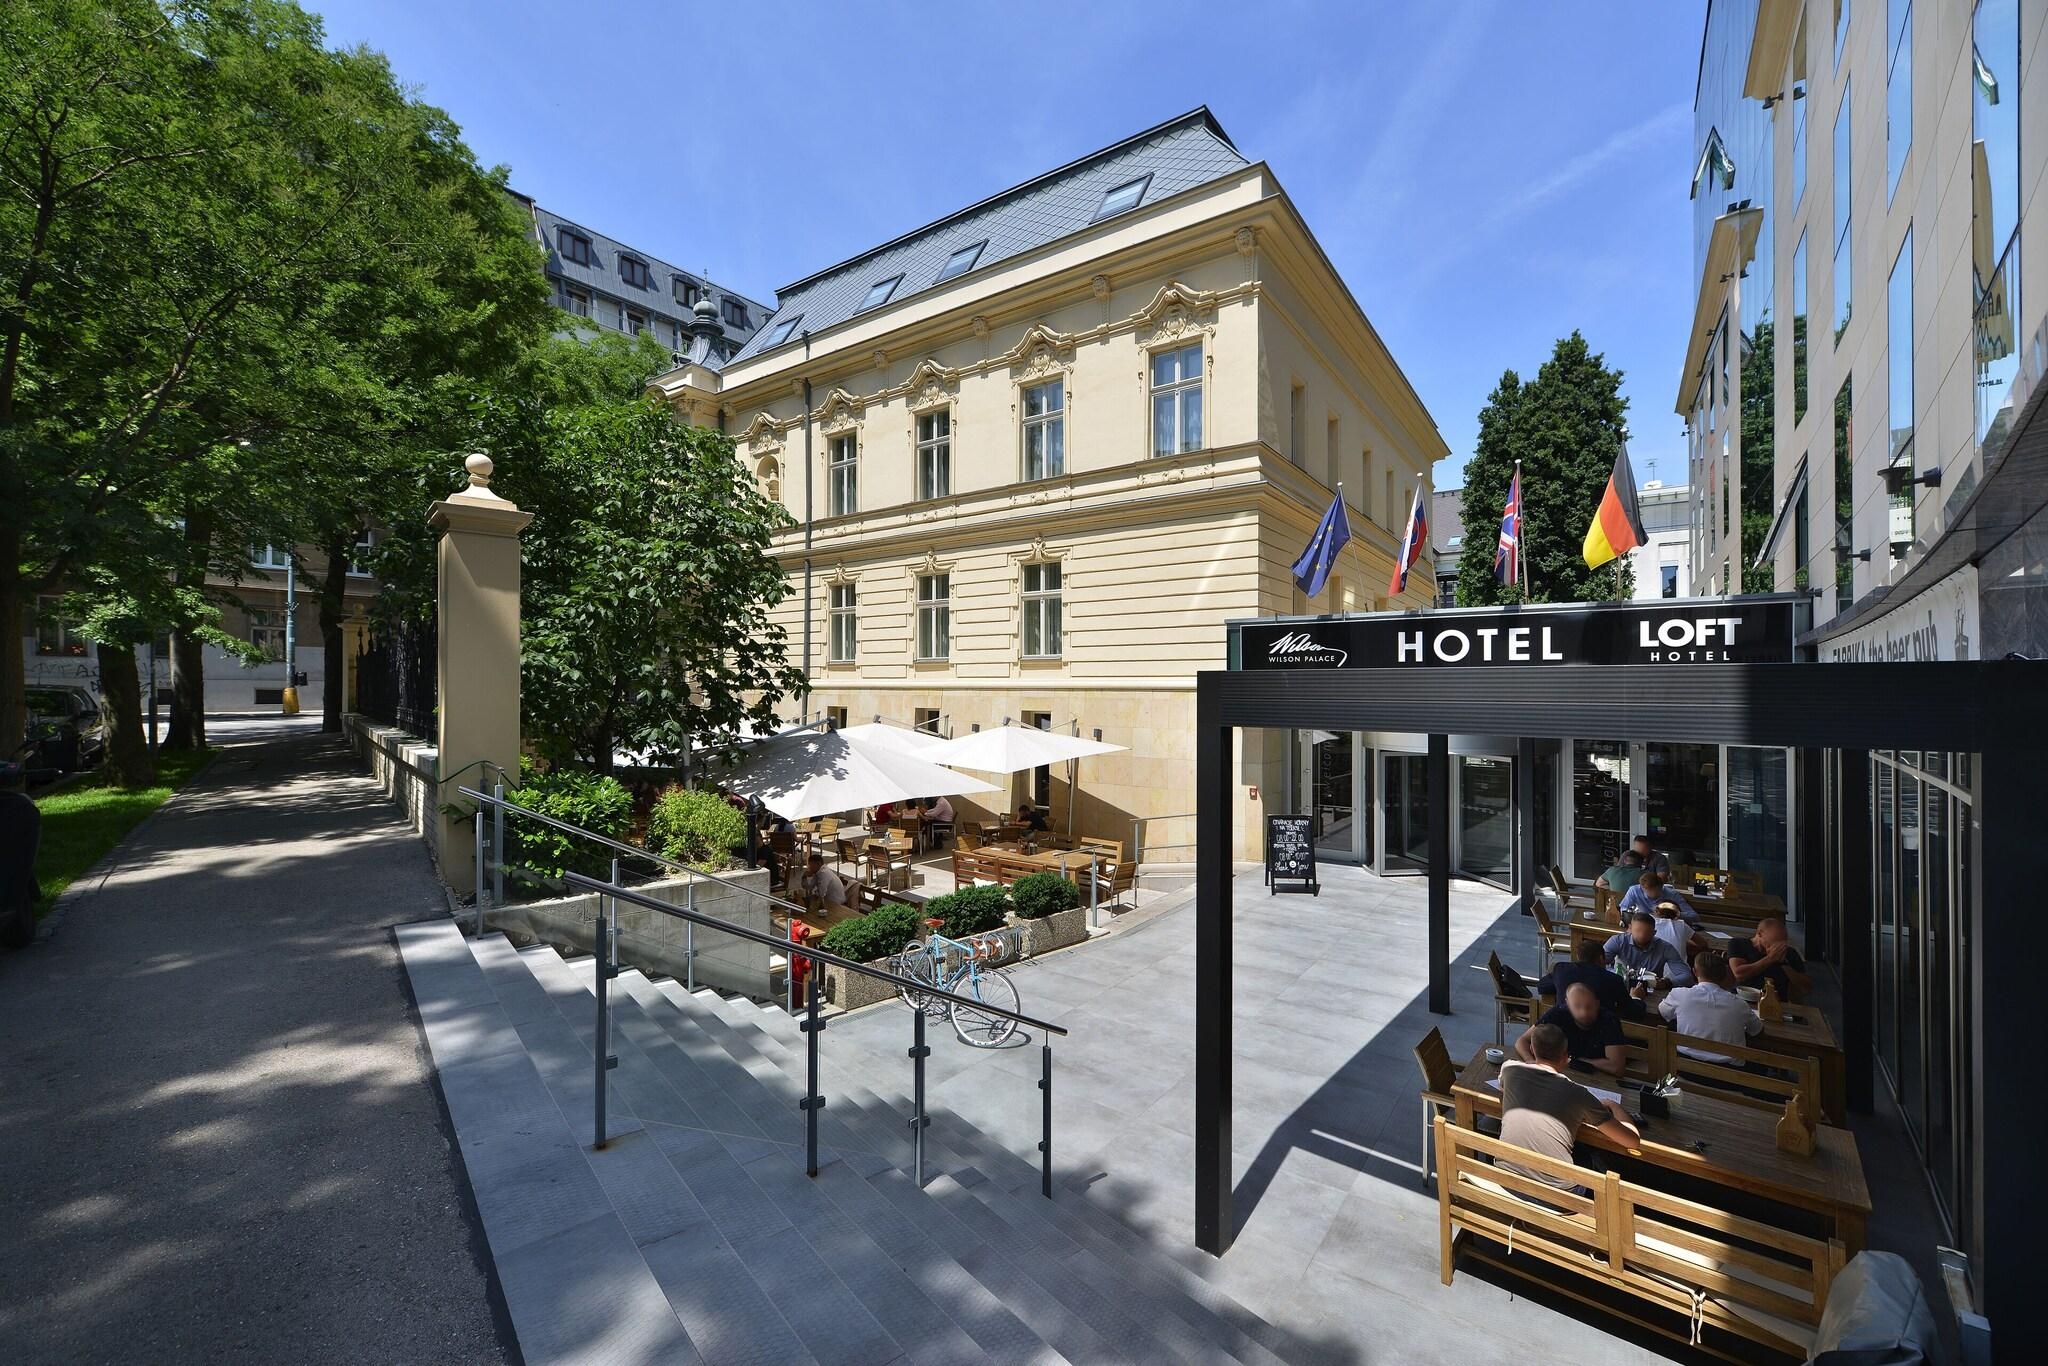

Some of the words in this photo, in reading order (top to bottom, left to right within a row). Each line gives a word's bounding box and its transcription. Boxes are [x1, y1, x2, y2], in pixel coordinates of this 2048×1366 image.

[1397, 626, 1563, 663] HOTEL
[1639, 618, 1743, 647] LOFT
[1650, 651, 1731, 661] HOTEL
